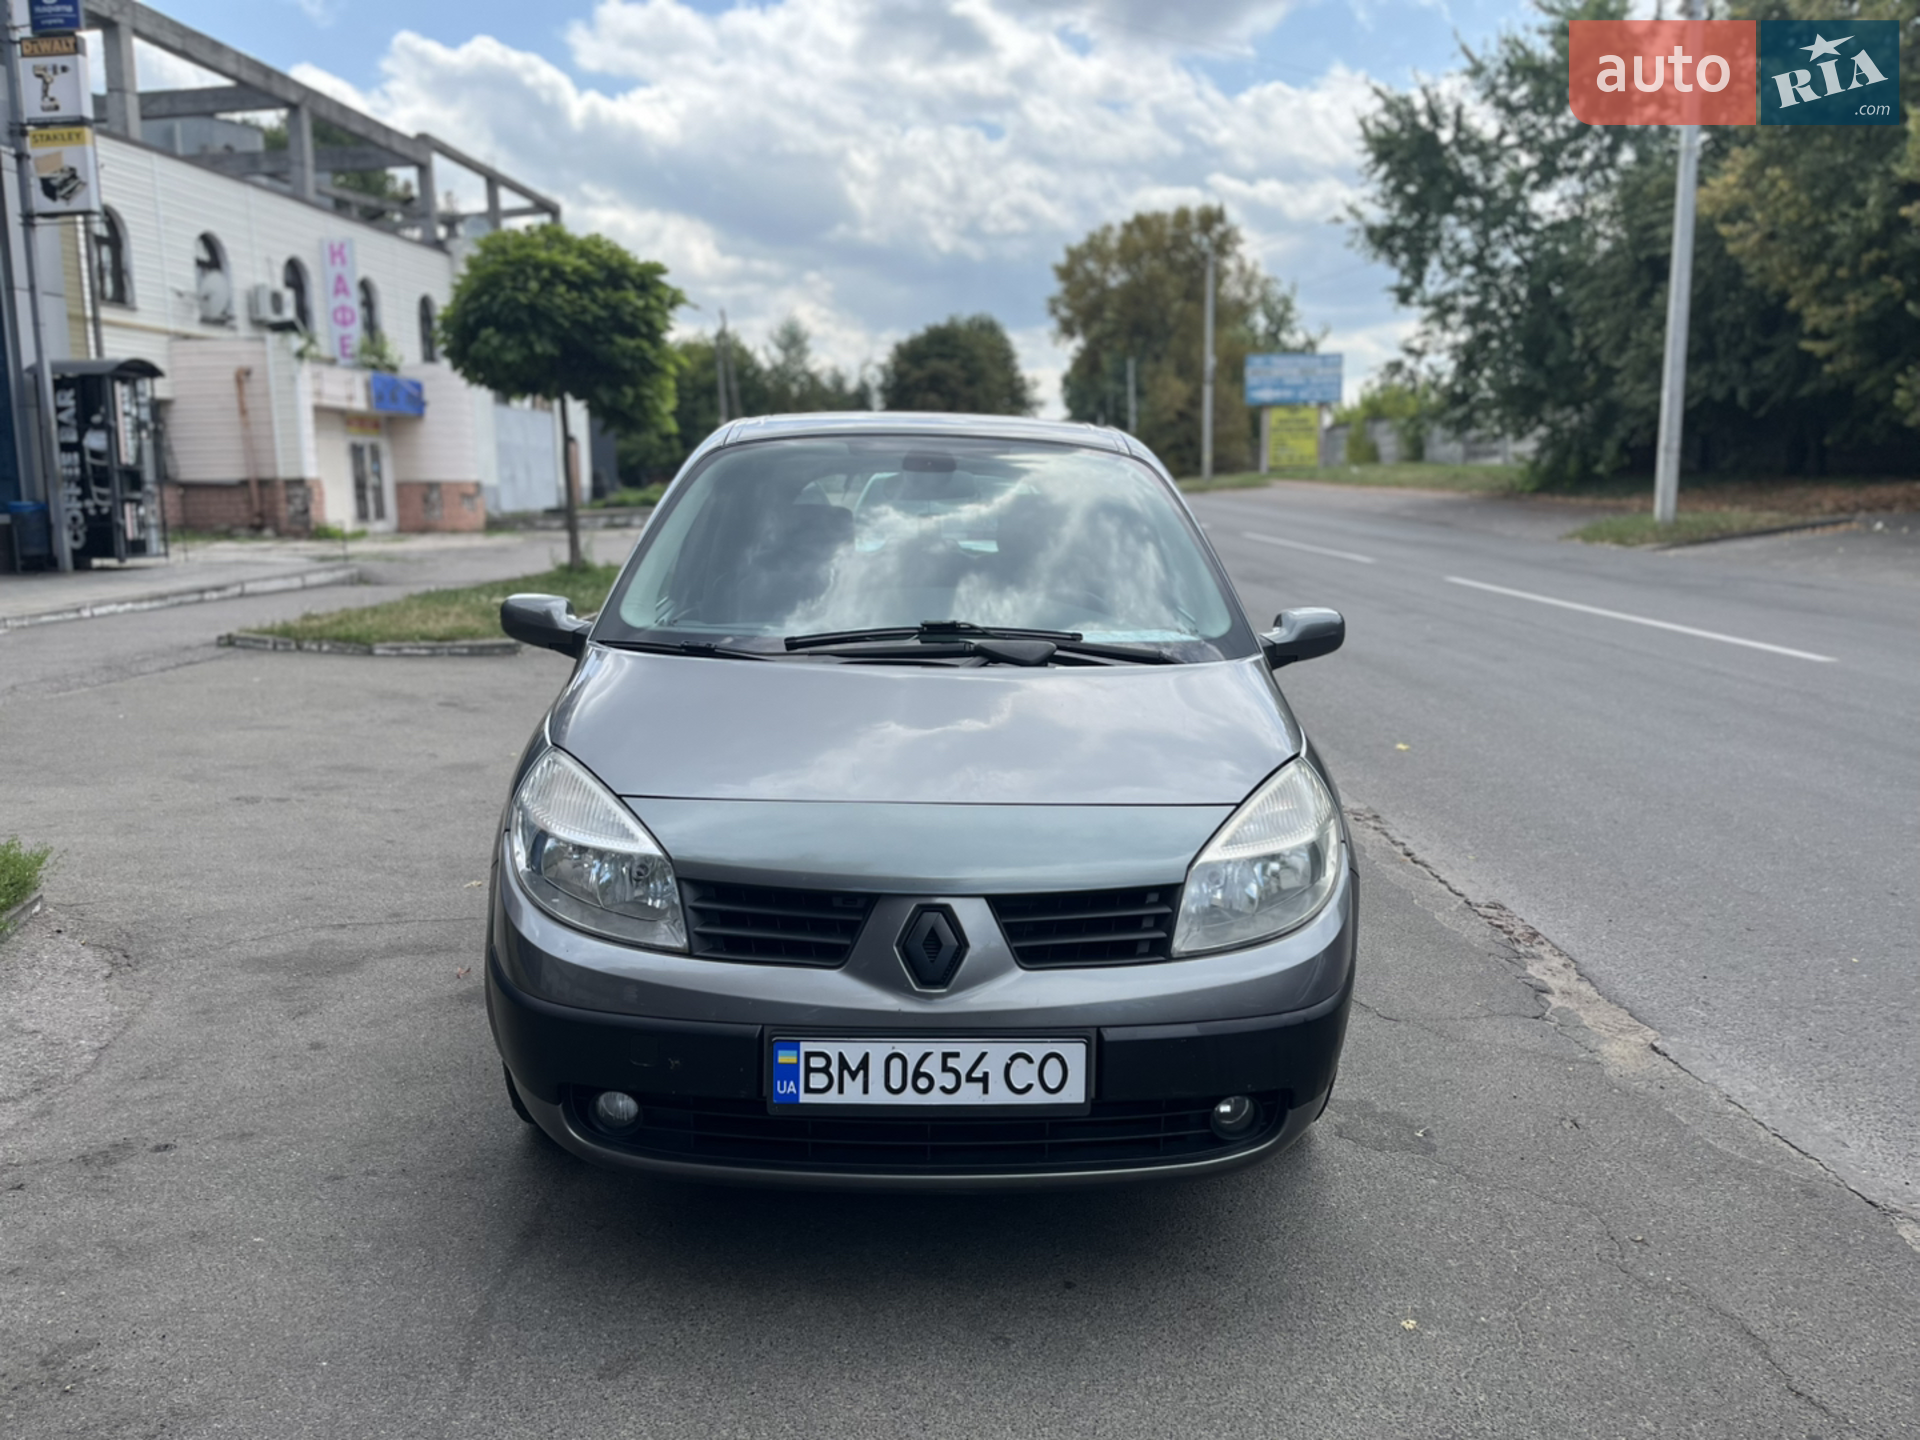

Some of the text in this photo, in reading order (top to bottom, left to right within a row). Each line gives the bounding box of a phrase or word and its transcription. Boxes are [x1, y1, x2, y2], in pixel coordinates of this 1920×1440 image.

[32, 132, 82, 144] STANLEY
[328, 240, 357, 360] КАФЕ
[56, 388, 79, 443] BAR
[777, 1080, 797, 1094] UA
[803, 1051, 1069, 1095] BM 0654 CO
